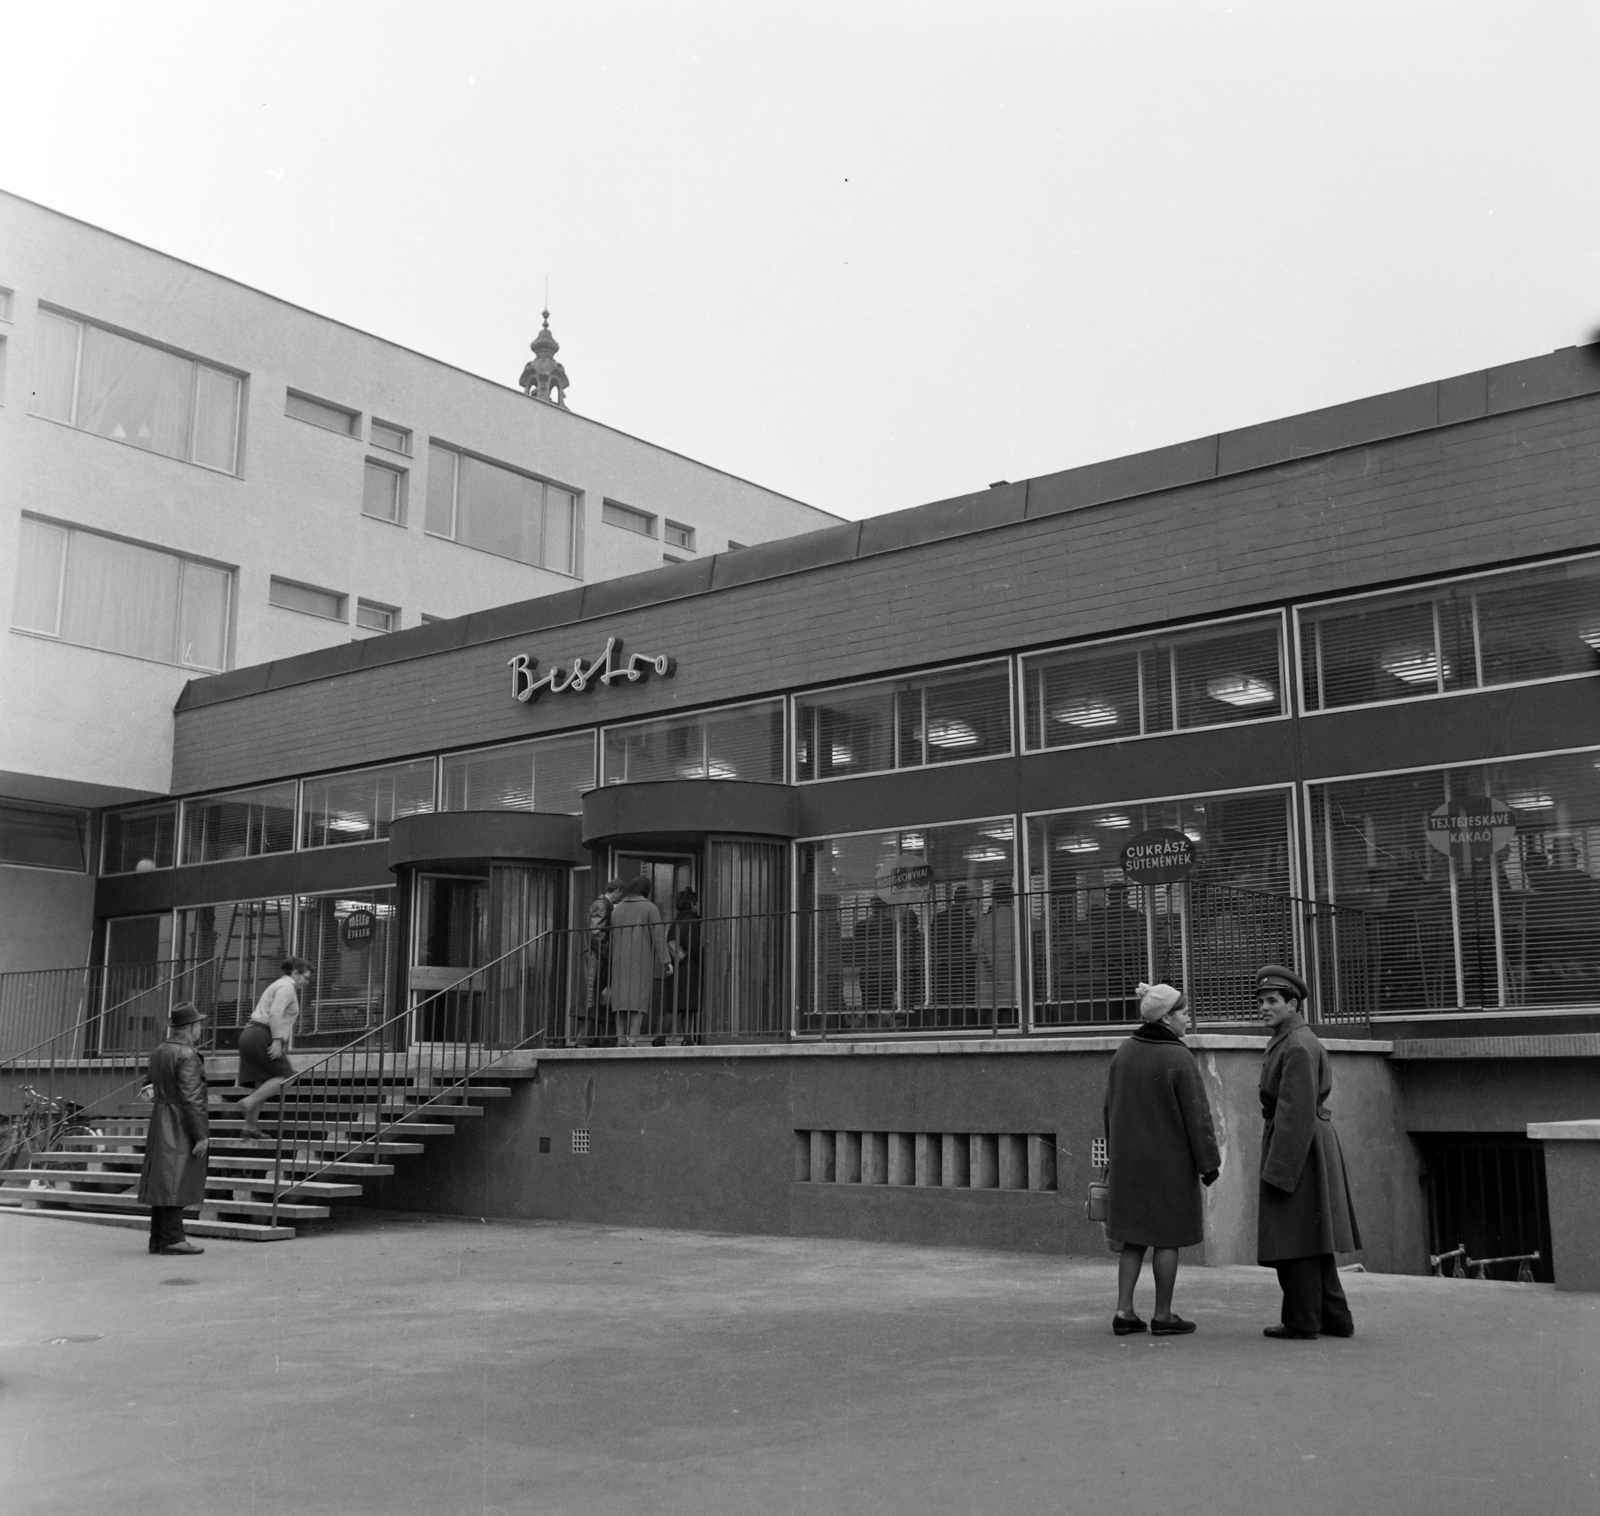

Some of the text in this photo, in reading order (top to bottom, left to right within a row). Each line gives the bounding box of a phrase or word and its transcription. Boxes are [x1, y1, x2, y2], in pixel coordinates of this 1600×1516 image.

[507, 636, 669, 702] Bistro
[1451, 811, 1509, 828] TEJESKÁVÉ
[1450, 828, 1491, 843] KAKAÓ
[1126, 838, 1189, 858] CUKRÁSZ-
[1126, 853, 1192, 871] SÜTEMÉNYEK
